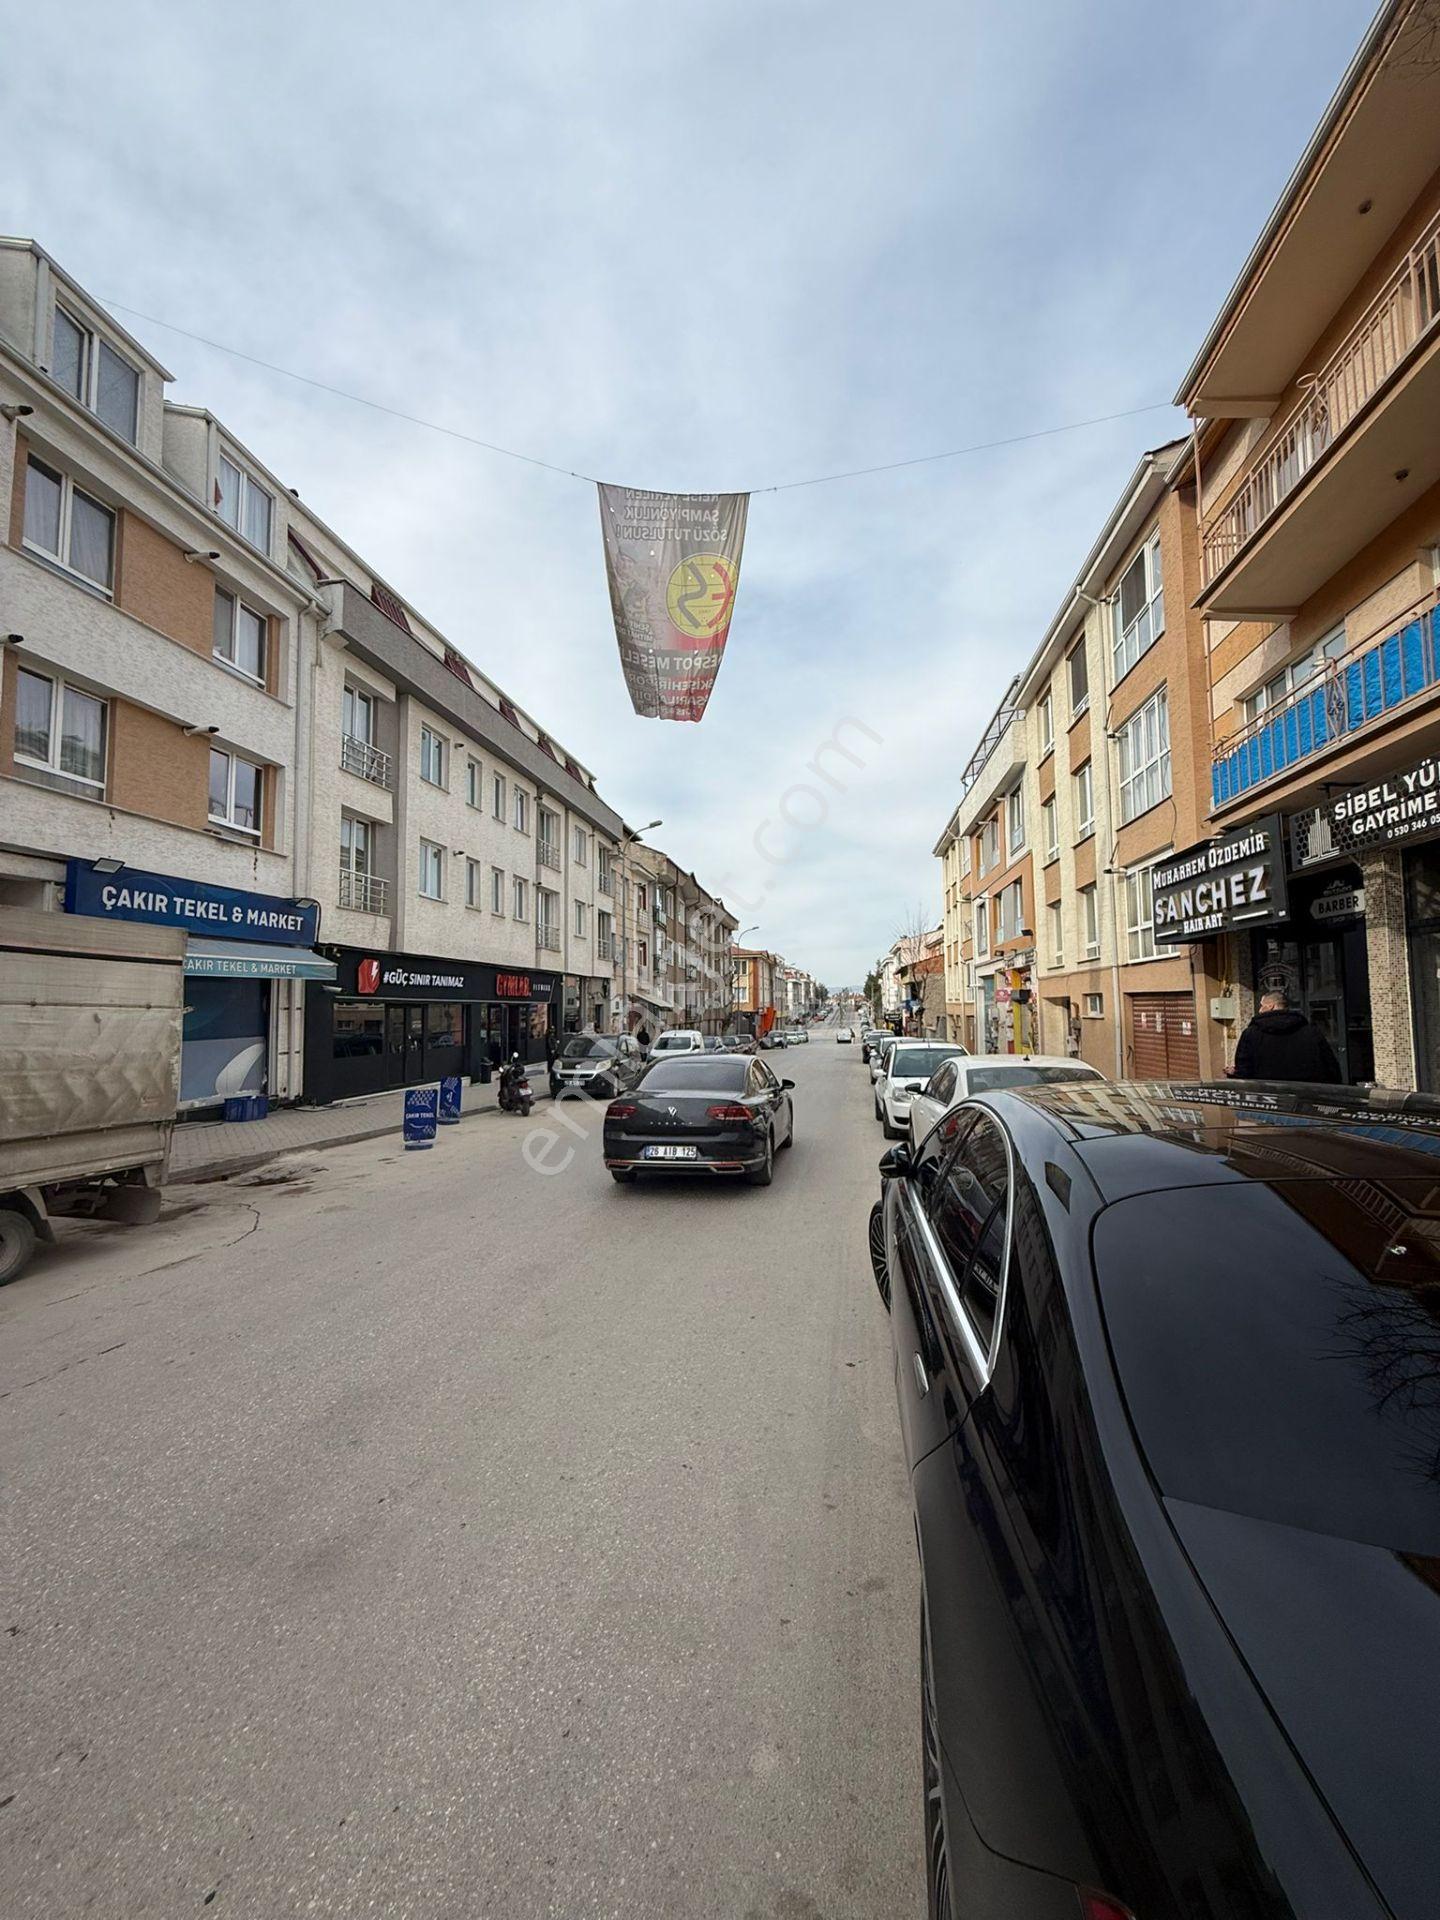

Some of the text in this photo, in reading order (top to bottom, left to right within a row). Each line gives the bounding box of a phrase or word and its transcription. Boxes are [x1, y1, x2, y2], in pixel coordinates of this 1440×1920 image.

[1334, 759, 1440, 820] SİBEL YÜ
[1352, 791, 1438, 835] GAYRİME
[1394, 824, 1409, 837] 530
[1153, 829, 1265, 890] MUHARREM ÖZDEMİR
[102, 886, 304, 931] ÇAKIR TEKEL & MARKET
[1155, 866, 1267, 925] SANCHEZ
[1319, 895, 1359, 914] BARBER
[1183, 913, 1223, 934] HAIR ART
[218, 960, 248, 972] TEKEL
[251, 963, 257, 973] &
[261, 964, 296, 975] MARKET
[383, 968, 464, 987] #GÜÇ SINIR TANIMAZ
